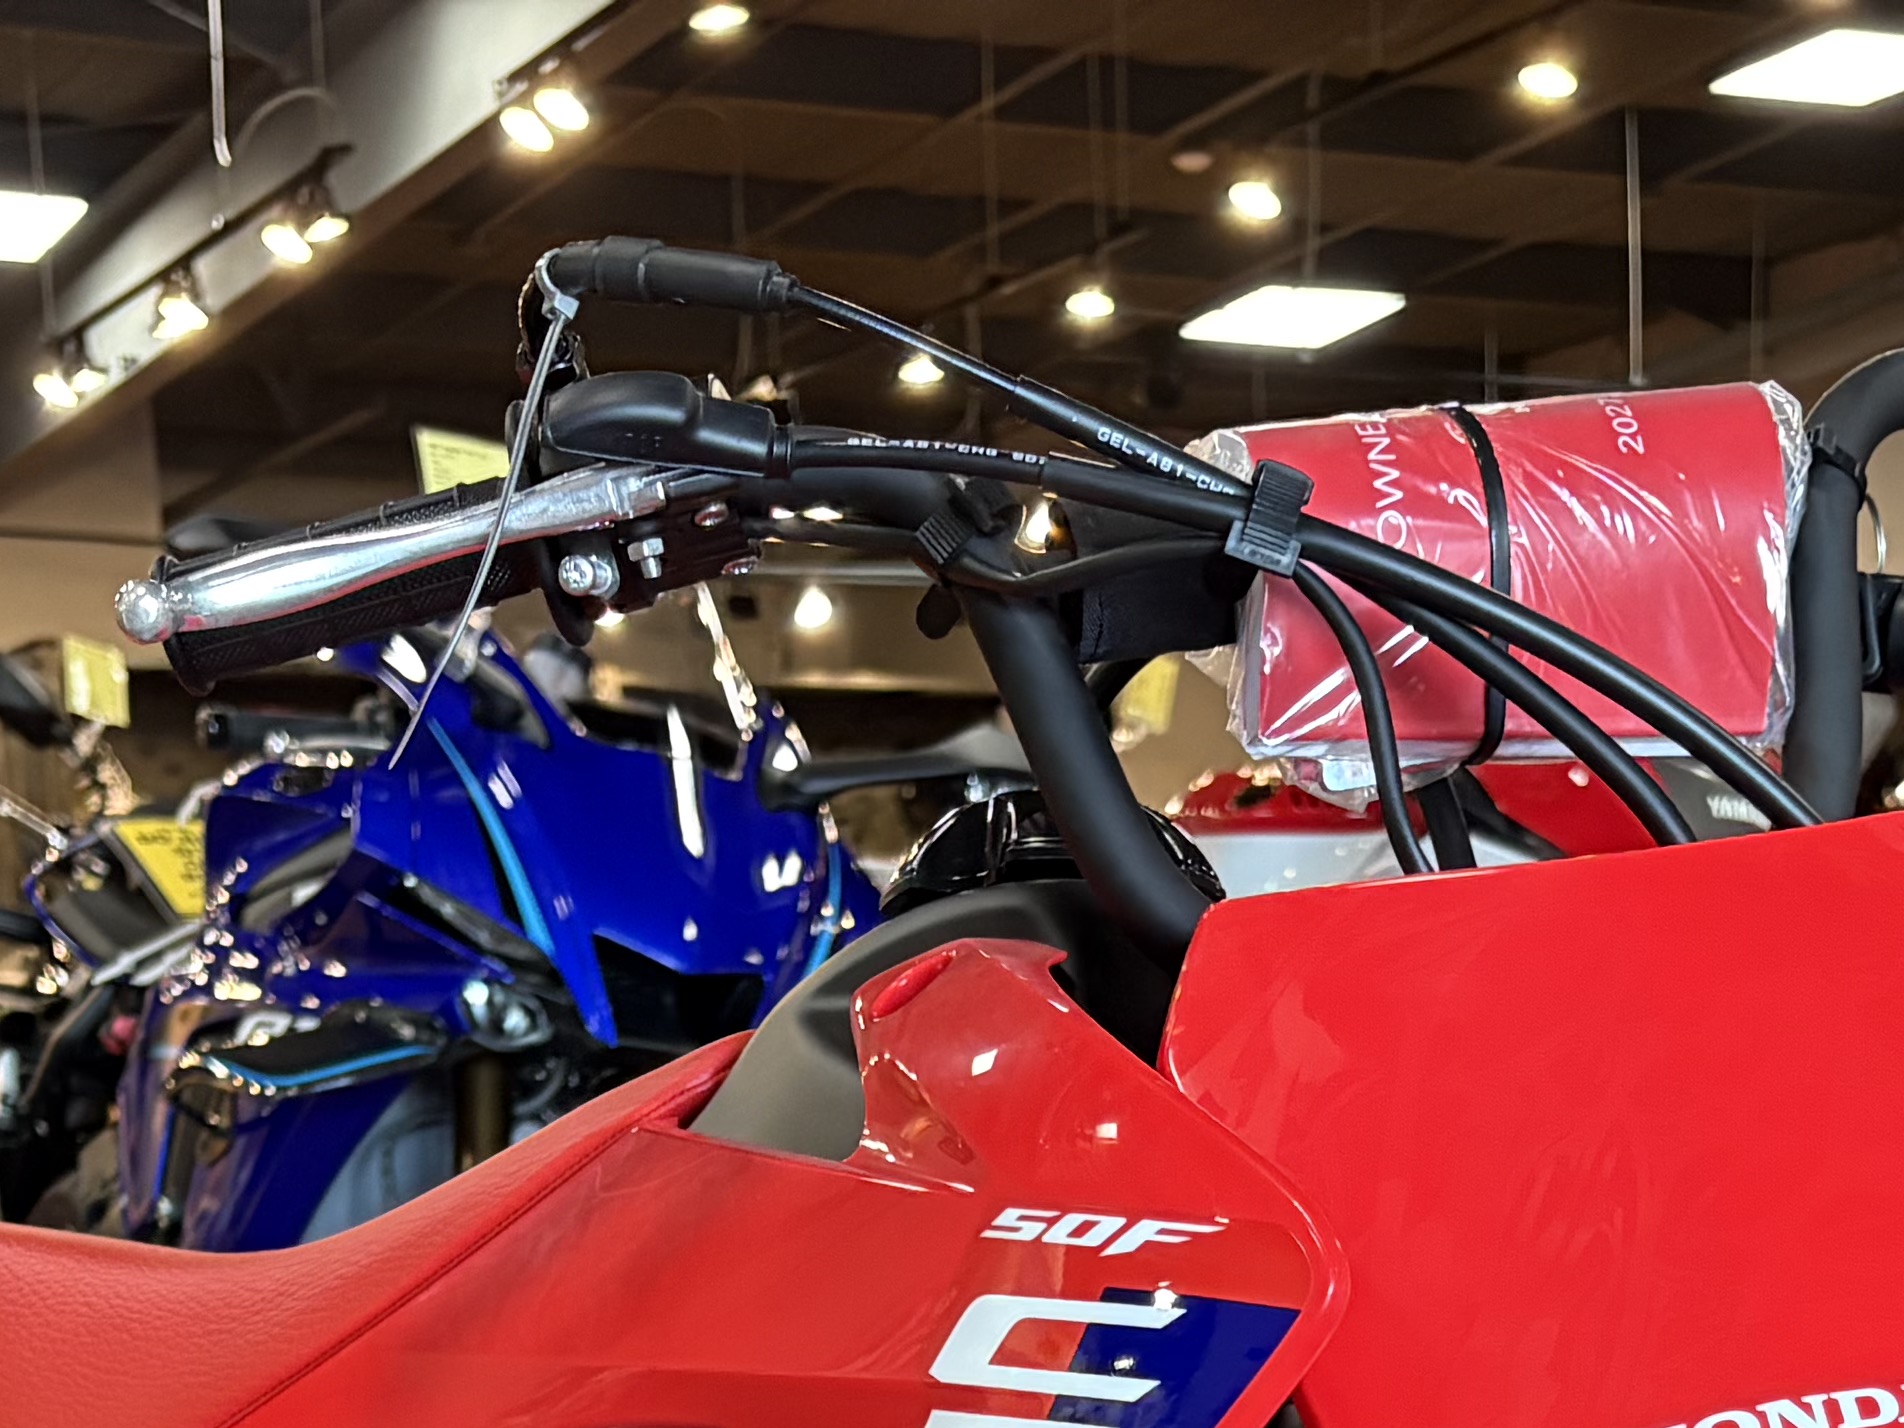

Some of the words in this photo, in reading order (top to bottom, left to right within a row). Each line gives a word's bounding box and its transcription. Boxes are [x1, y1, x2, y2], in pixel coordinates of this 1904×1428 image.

[1354, 418, 1407, 550] OWNE
[1707, 796, 1772, 833] YAM
[980, 1207, 1228, 1256] 50F
